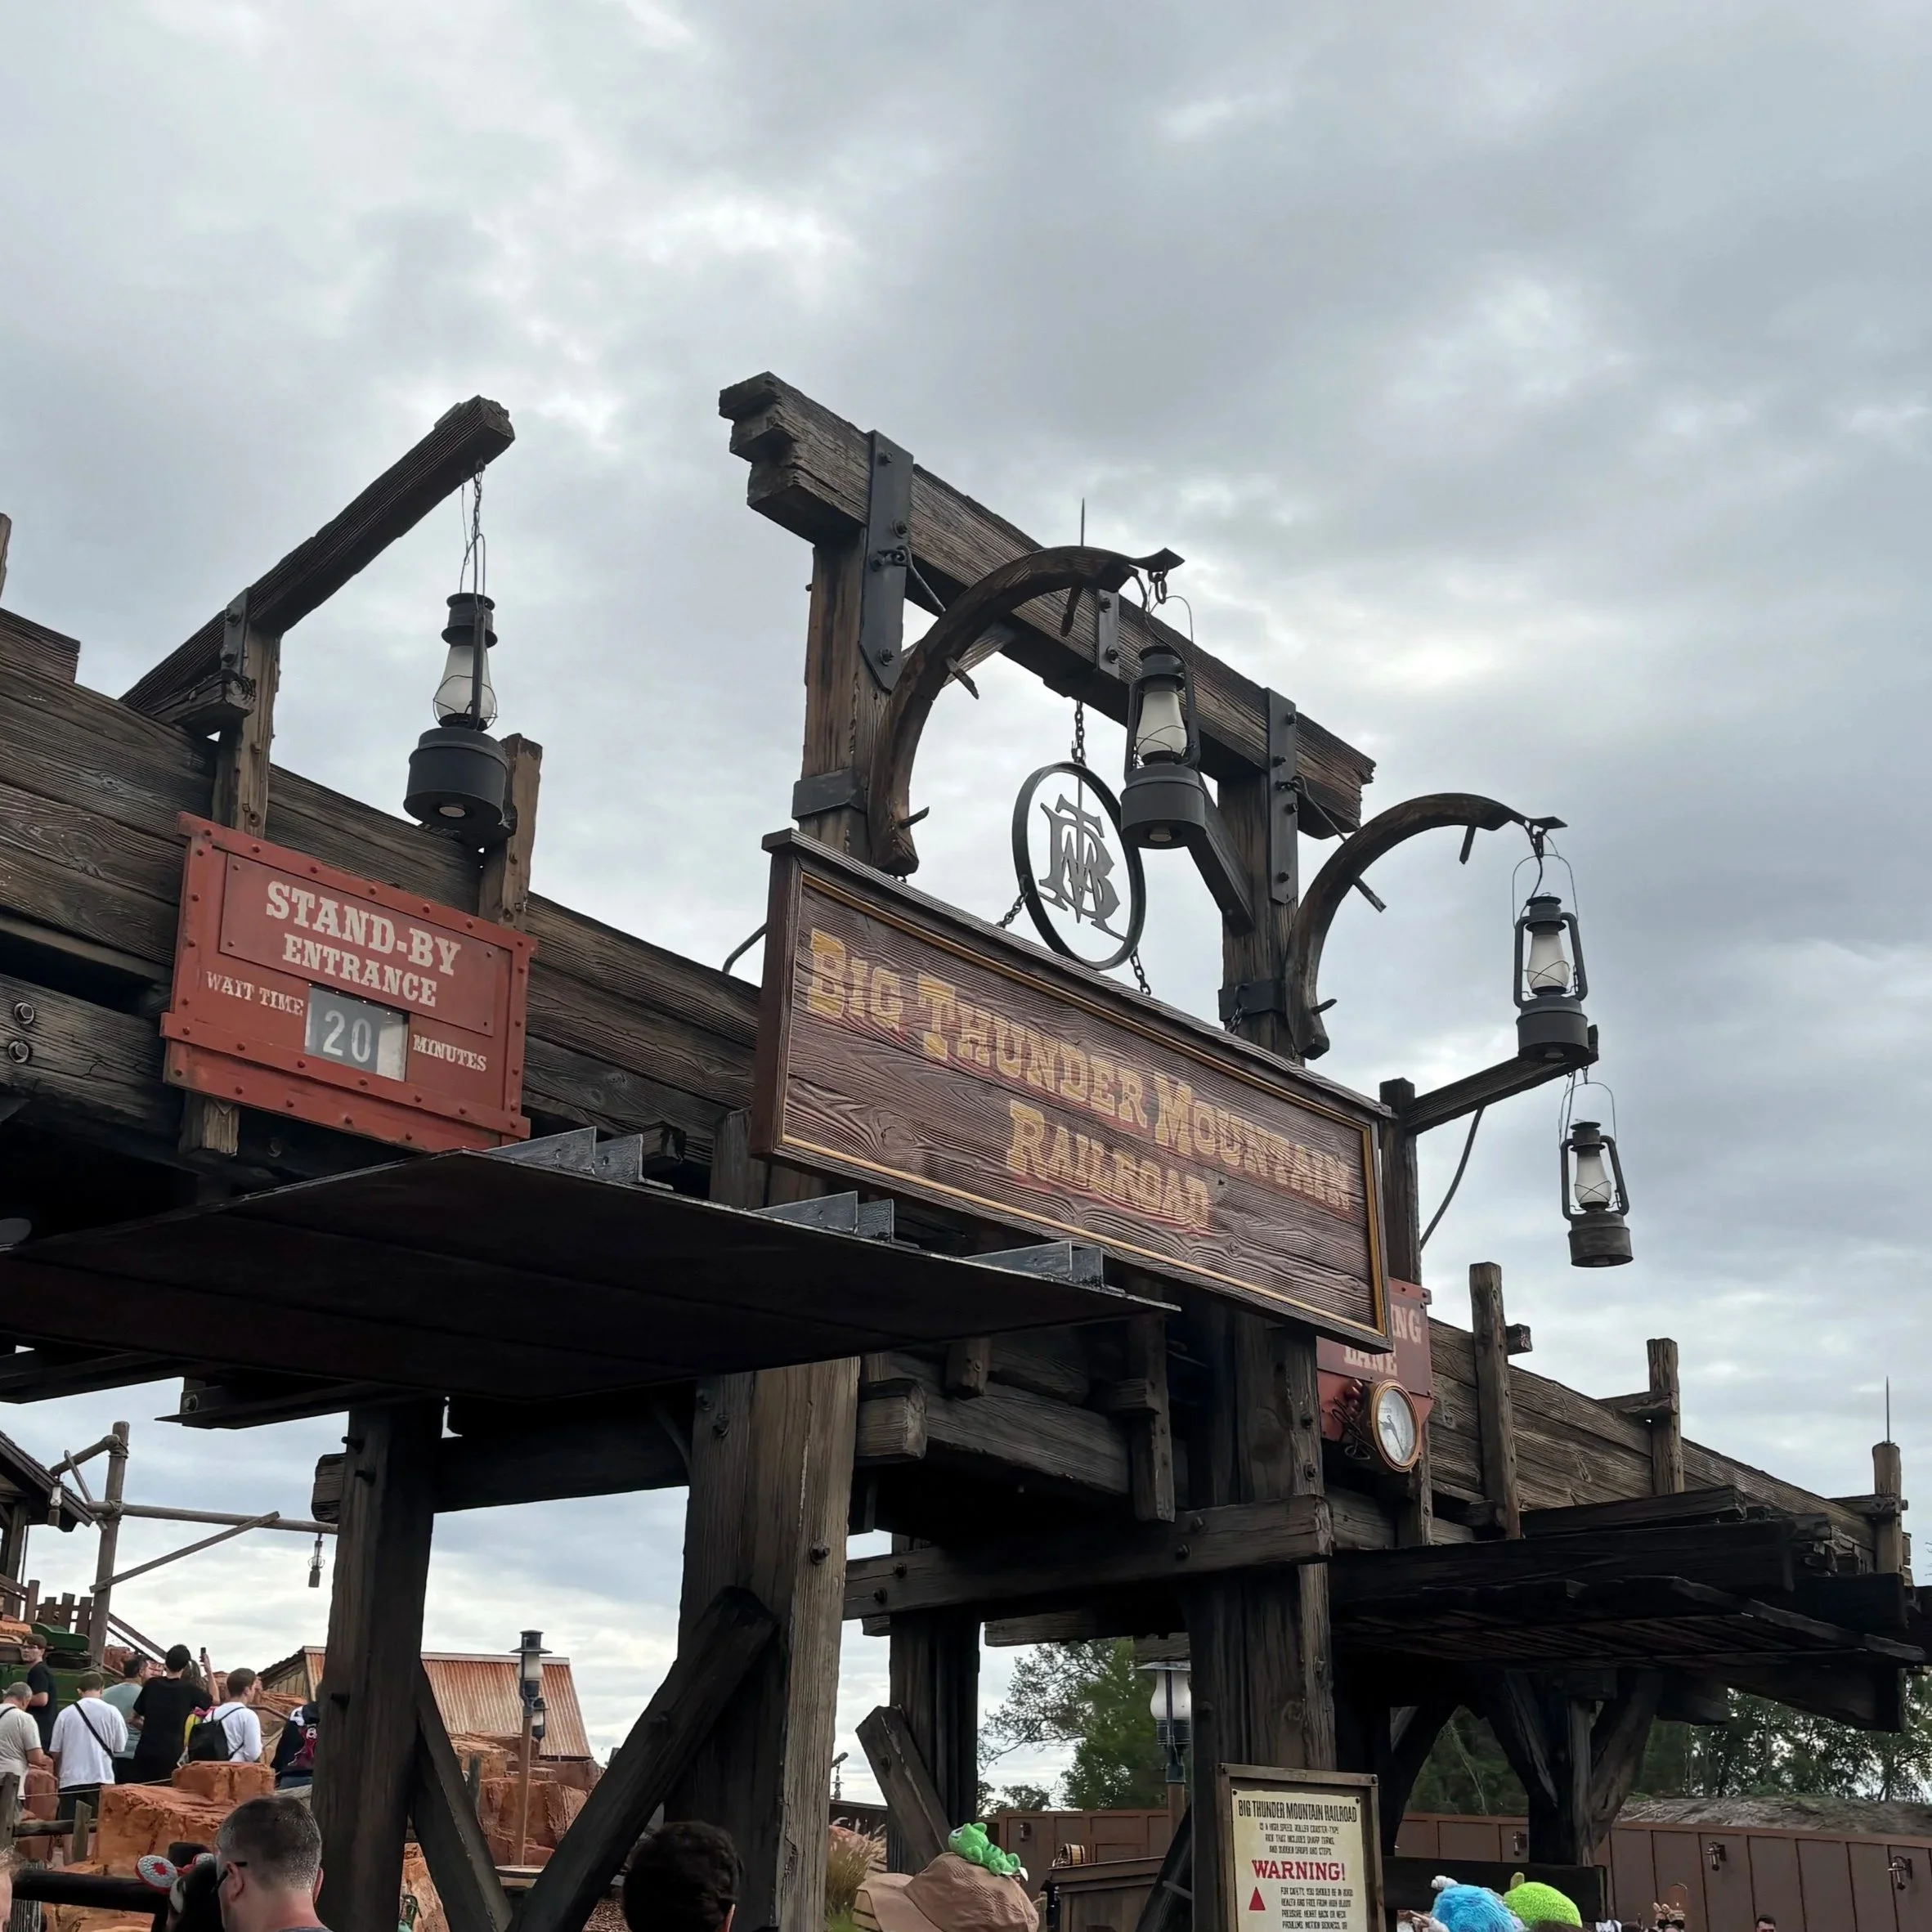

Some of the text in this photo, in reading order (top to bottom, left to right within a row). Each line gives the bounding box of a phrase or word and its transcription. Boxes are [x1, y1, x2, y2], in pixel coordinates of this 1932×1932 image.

[266, 881, 461, 976] STAND-BY
[206, 970, 304, 1015] WAIT TIME
[282, 933, 437, 1007] ENTRANCE
[323, 1010, 371, 1062] 20
[413, 1033, 486, 1072] MINUTES
[808, 929, 1352, 1212] BIG THUNDER MOUNTAIN
[1006, 1099, 1213, 1233] RAILROAD
[1239, 1800, 1356, 1822] BIG THUNDER MOUNTAIN RAILROAD
[1252, 1859, 1345, 1880] WARNING!
